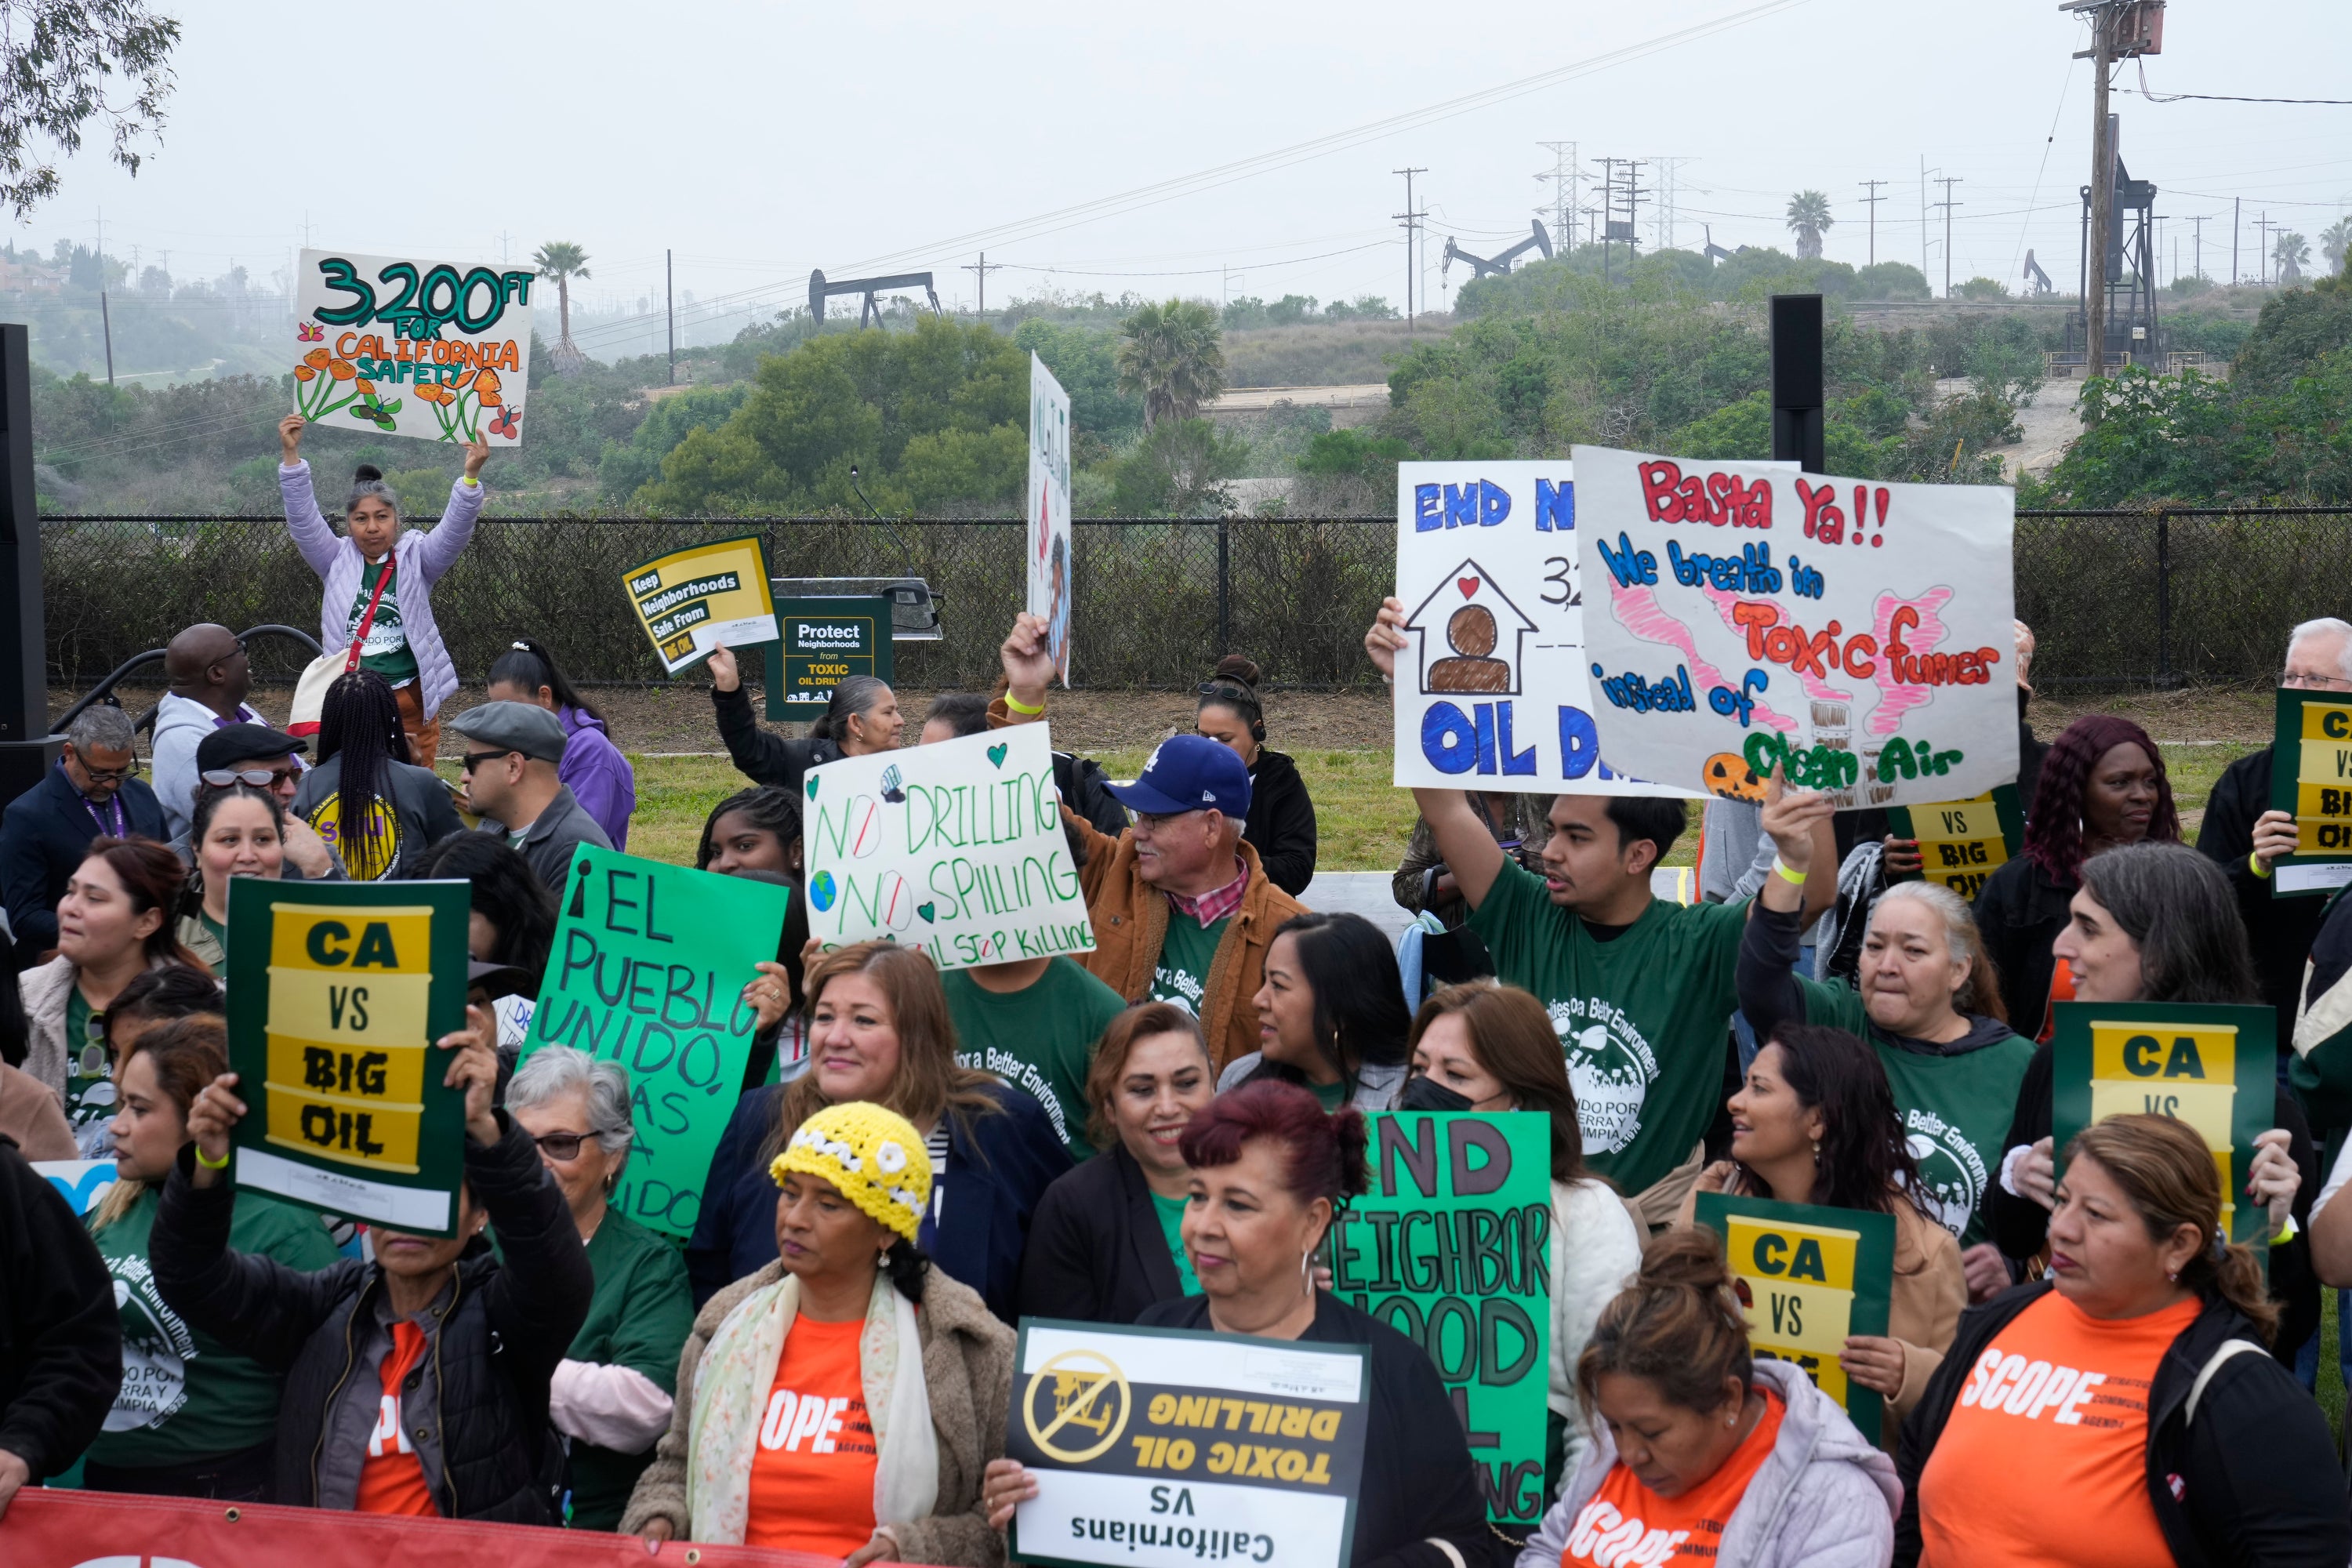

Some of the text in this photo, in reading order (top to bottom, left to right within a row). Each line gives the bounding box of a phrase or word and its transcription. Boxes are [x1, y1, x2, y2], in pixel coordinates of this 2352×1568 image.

[336, 332, 519, 372] CALIFORNIA
[394, 318, 441, 340] FOR
[357, 357, 463, 385] SAFETY
[1415, 479, 1512, 532] END
[1639, 461, 1890, 547] Basta Ya!!
[630, 574, 659, 594] Keep
[1598, 532, 1824, 600] We breath in
[641, 572, 737, 618] Neighborhoods
[652, 607, 706, 639] Safe From
[798, 624, 860, 639] Protect
[798, 641, 861, 649] Neighborhoods
[1733, 602, 2000, 685] Toxic fumes
[808, 664, 849, 676] TOXIC
[820, 652, 839, 661] from
[798, 677, 842, 686] OIL DRILL
[1591, 662, 1769, 728] instead of
[1421, 700, 1537, 776] OIL
[2322, 711, 2352, 739] C
[1744, 731, 1964, 789] Clean Air
[811, 766, 1056, 873] NO DRILLING
[1941, 811, 1968, 835] VS
[2321, 789, 2352, 818] BI
[1938, 841, 1988, 869] BIG
[2318, 825, 2352, 848] OI
[839, 851, 1079, 935] NO SPILLING
[307, 920, 399, 969] CA
[954, 930, 1006, 964] STOP
[1014, 920, 1097, 960] KILLING
[1174, 968, 1203, 1002] Better
[329, 985, 369, 1032] VS
[538, 996, 723, 1096] UNIDO,
[1610, 1007, 1661, 1084] Environment
[2122, 1035, 2206, 1080] CA
[303, 1047, 388, 1095] BIG
[973, 1051, 982, 1069] a
[986, 1047, 1025, 1080] Better
[1021, 1063, 1072, 1145] Environment
[1606, 1102, 1639, 1115] POR
[301, 1105, 385, 1158] OIL
[1618, 1116, 1627, 1127] Y
[1907, 1109, 1948, 1137] Better
[1377, 1114, 1512, 1197] ND
[115, 1254, 152, 1284] Better
[1333, 1203, 1551, 1297] EIGHBOR
[1753, 1233, 1828, 1283] CA
[1770, 1292, 1802, 1338] VS
[1961, 1348, 2107, 1425] SCOPE
[760, 1388, 849, 1454] OPE
[1148, 1392, 1342, 1443] DRILLING
[1131, 1435, 1332, 1485] TOXIC OIL
[1149, 1484, 1196, 1517] VS
[1070, 1515, 1275, 1563] Californians
